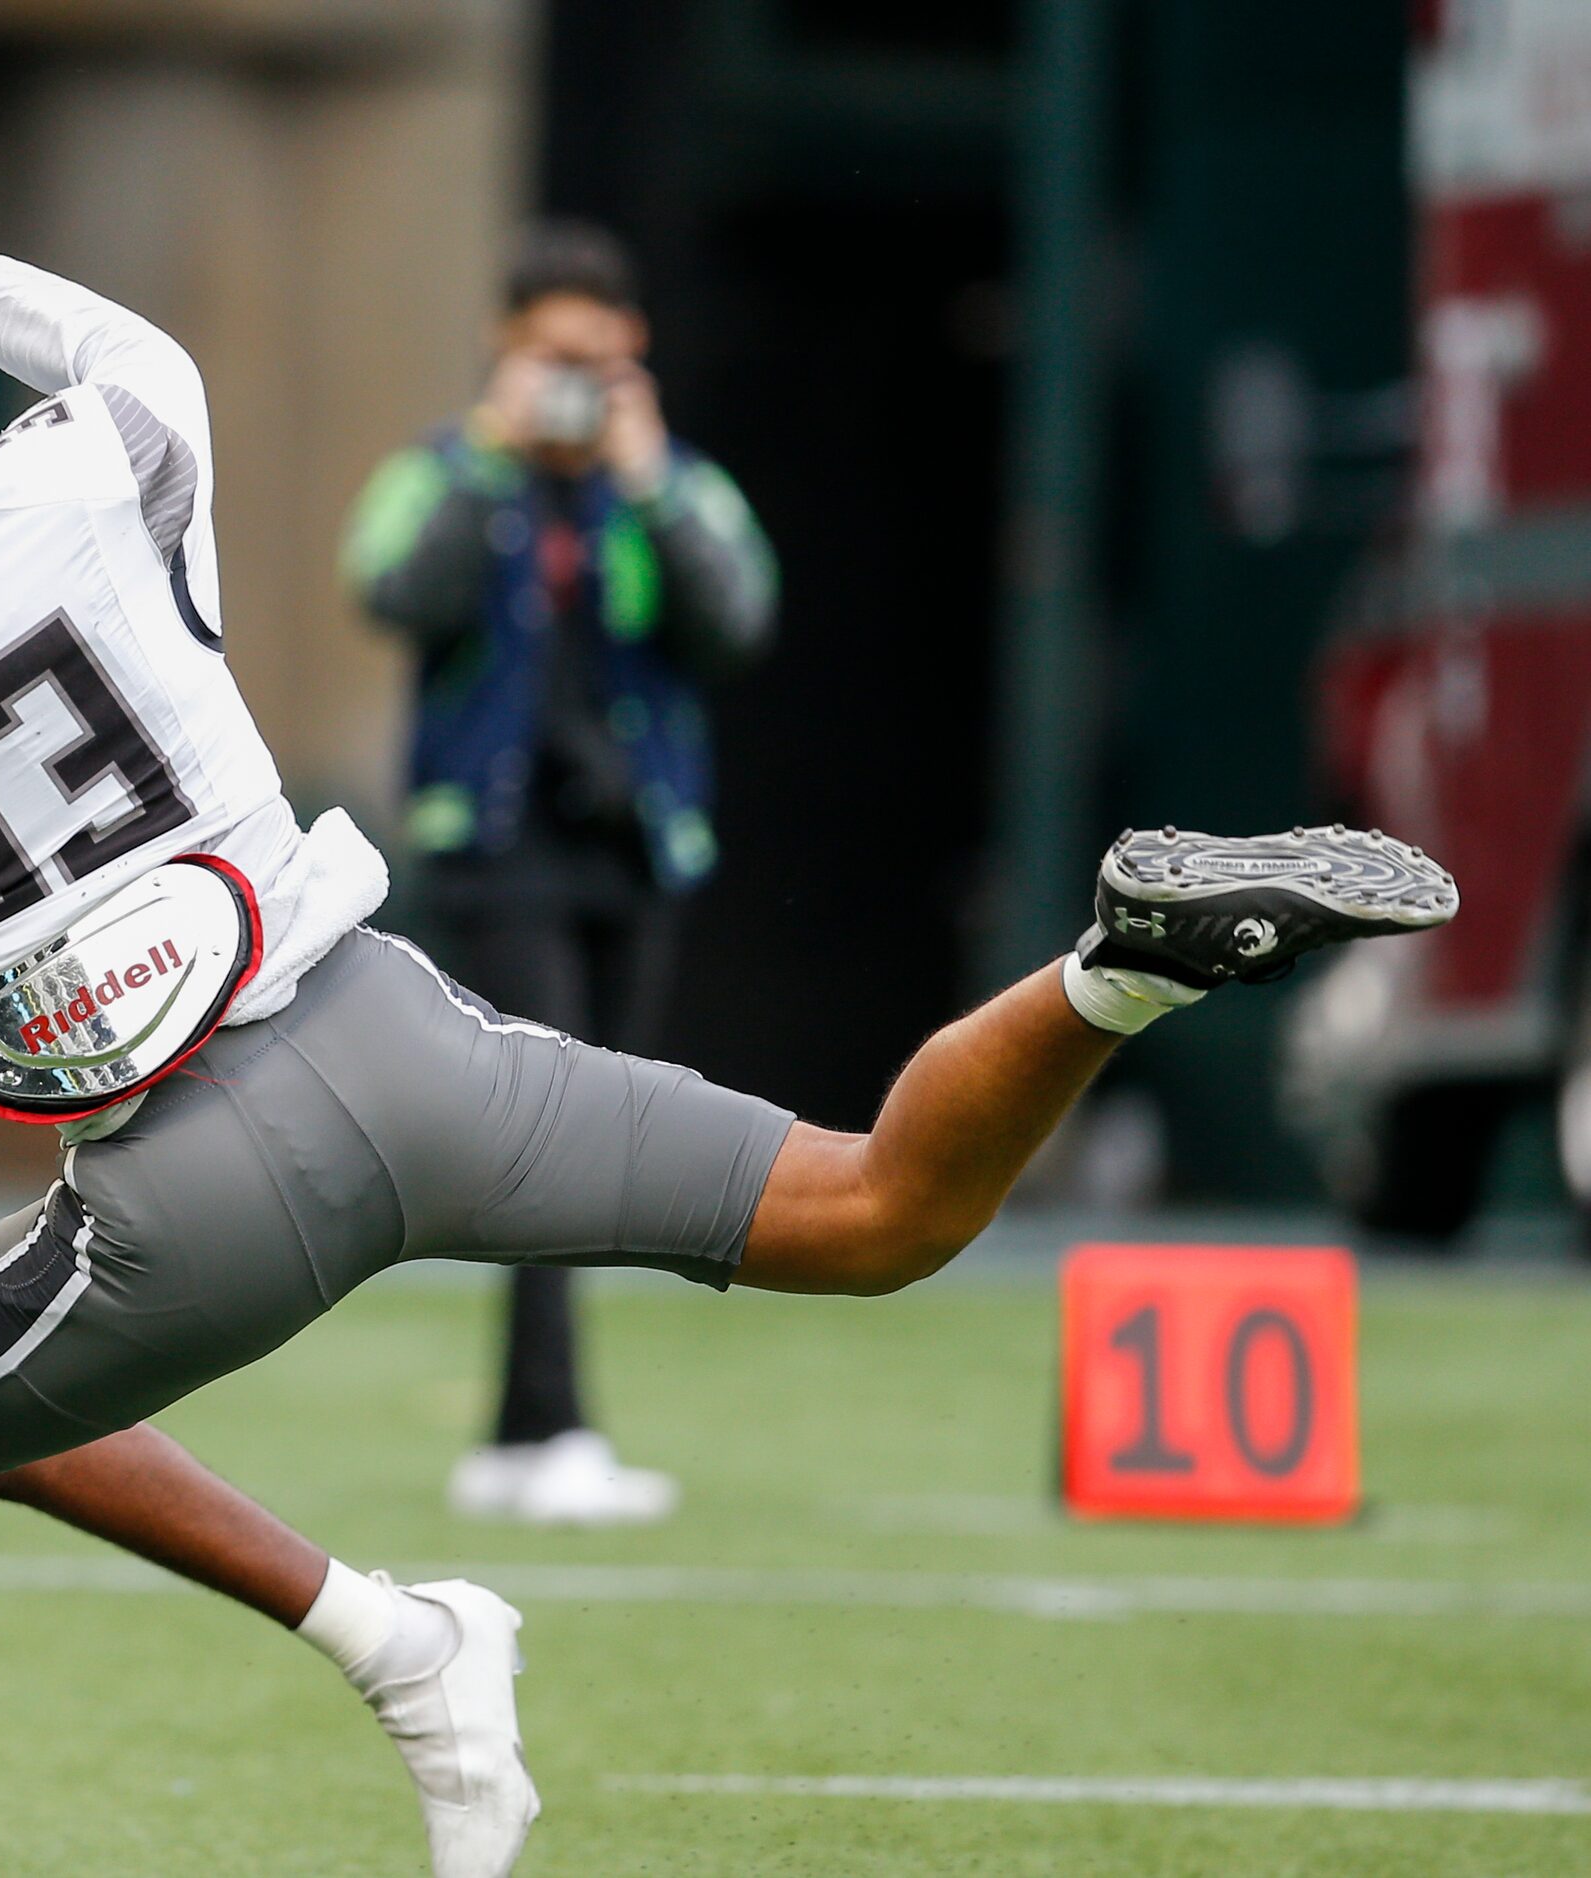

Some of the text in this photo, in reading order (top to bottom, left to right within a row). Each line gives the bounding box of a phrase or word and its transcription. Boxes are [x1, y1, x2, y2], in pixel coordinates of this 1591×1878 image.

[1192, 858, 1318, 871] UNDER ARMOUR
[18, 939, 183, 1056] Riddell
[1110, 1306, 1315, 1477] 10
